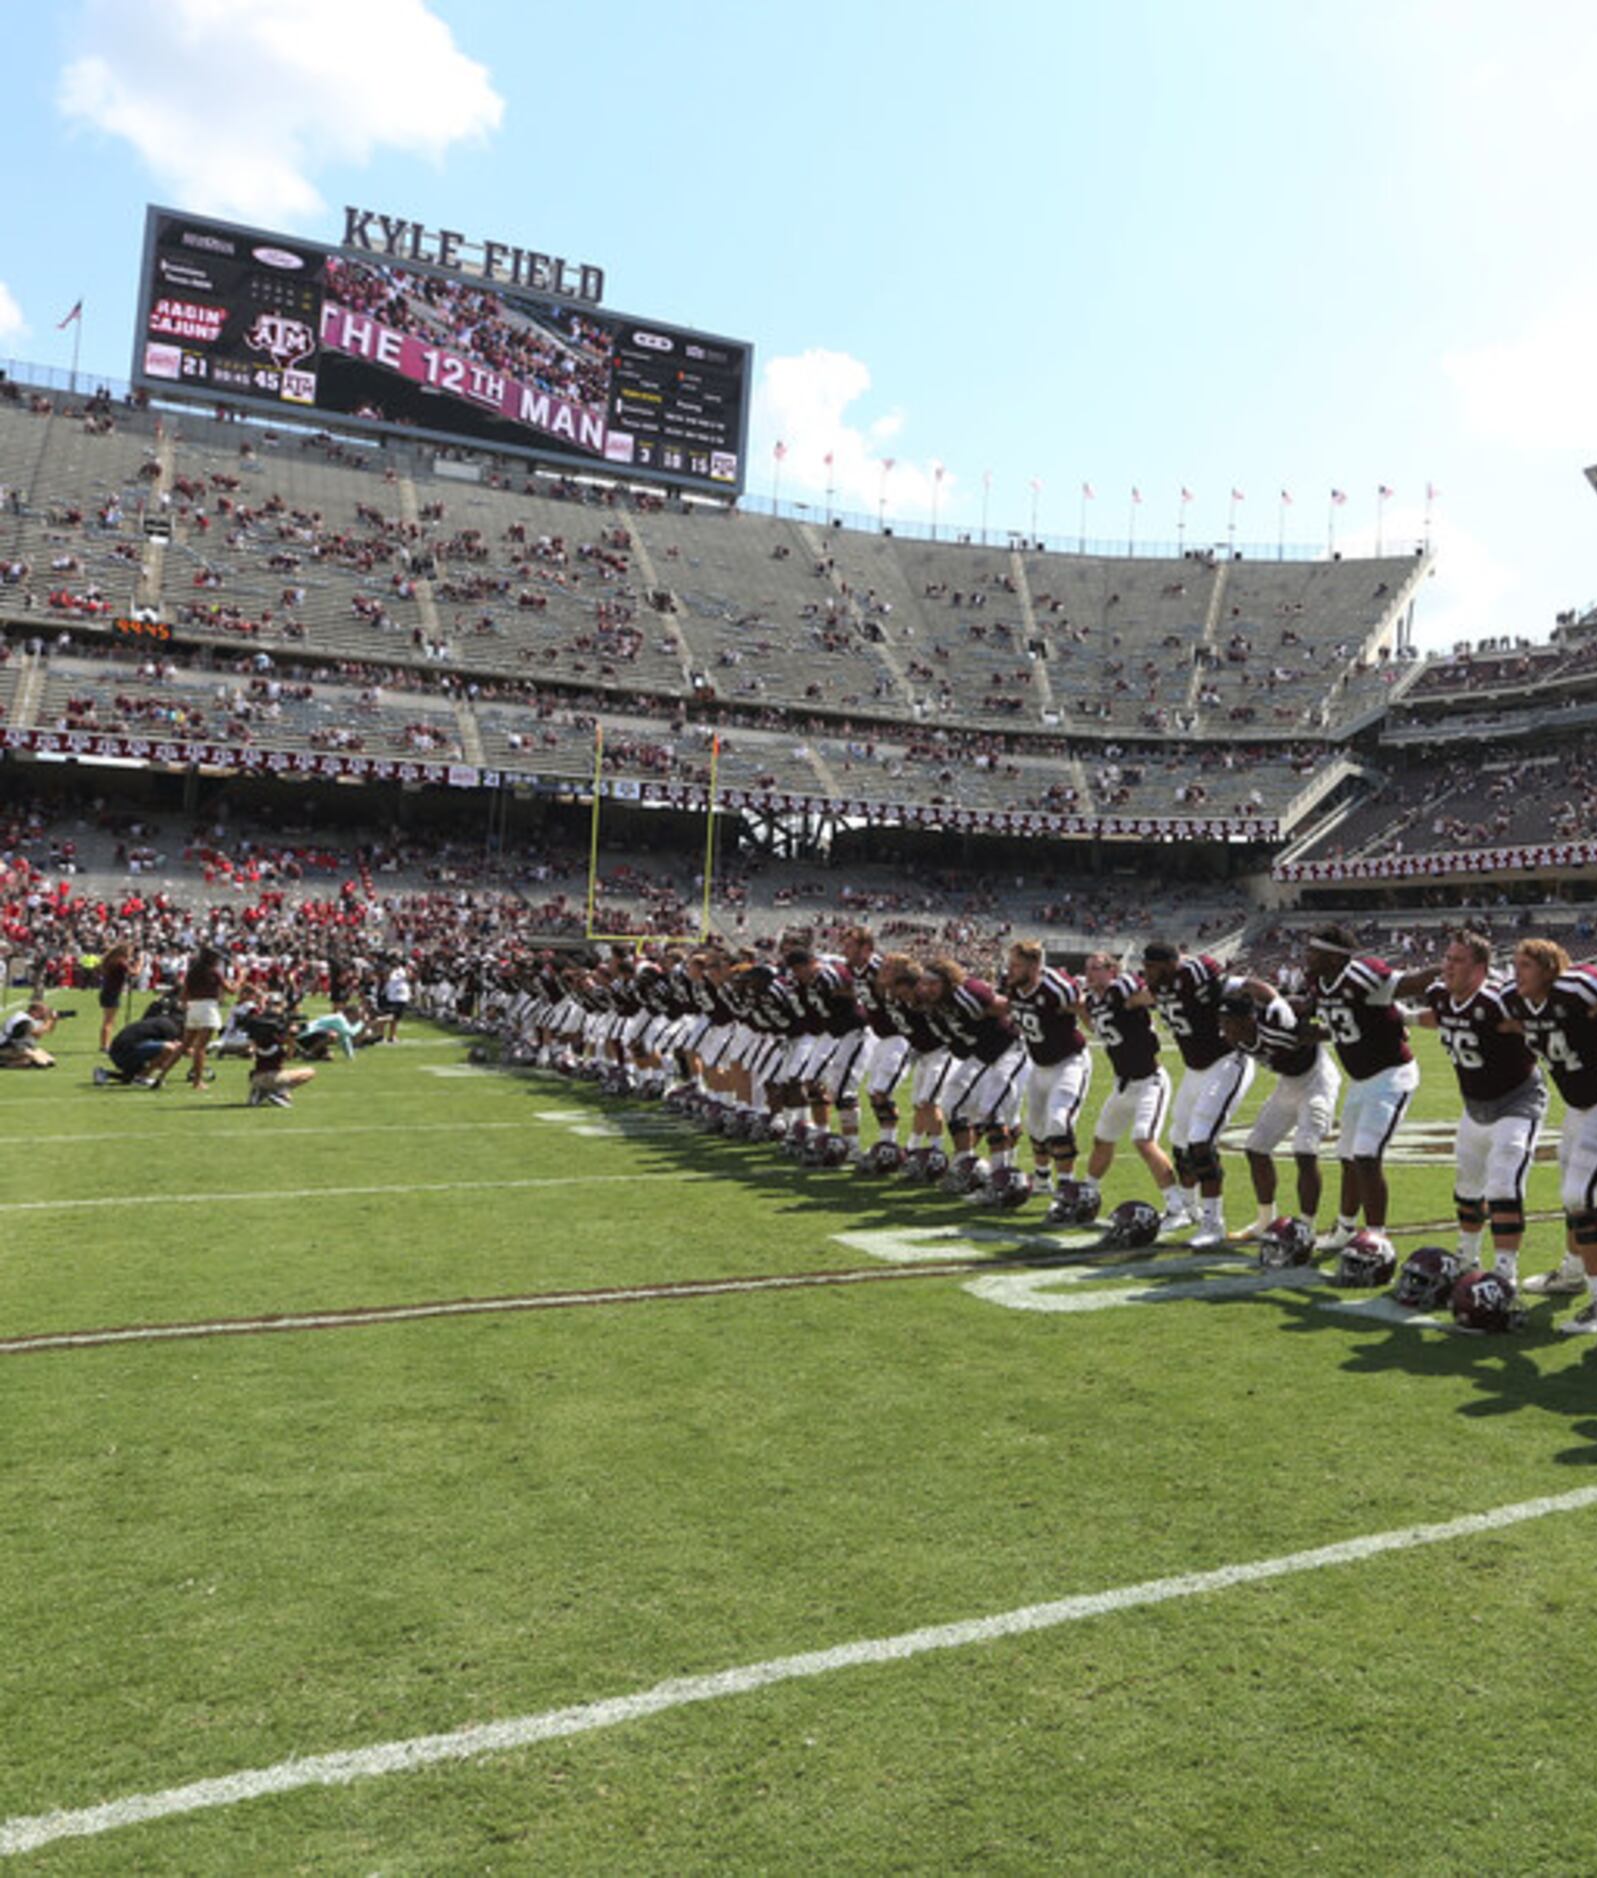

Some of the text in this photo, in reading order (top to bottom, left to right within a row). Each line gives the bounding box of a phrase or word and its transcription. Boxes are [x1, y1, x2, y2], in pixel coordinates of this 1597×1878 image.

[342, 205, 604, 304] KYLE FIELD
[183, 353, 208, 378] 21
[253, 369, 279, 391] 45
[320, 302, 403, 368] THE
[423, 350, 505, 407] 12TH
[520, 387, 603, 450] MAN
